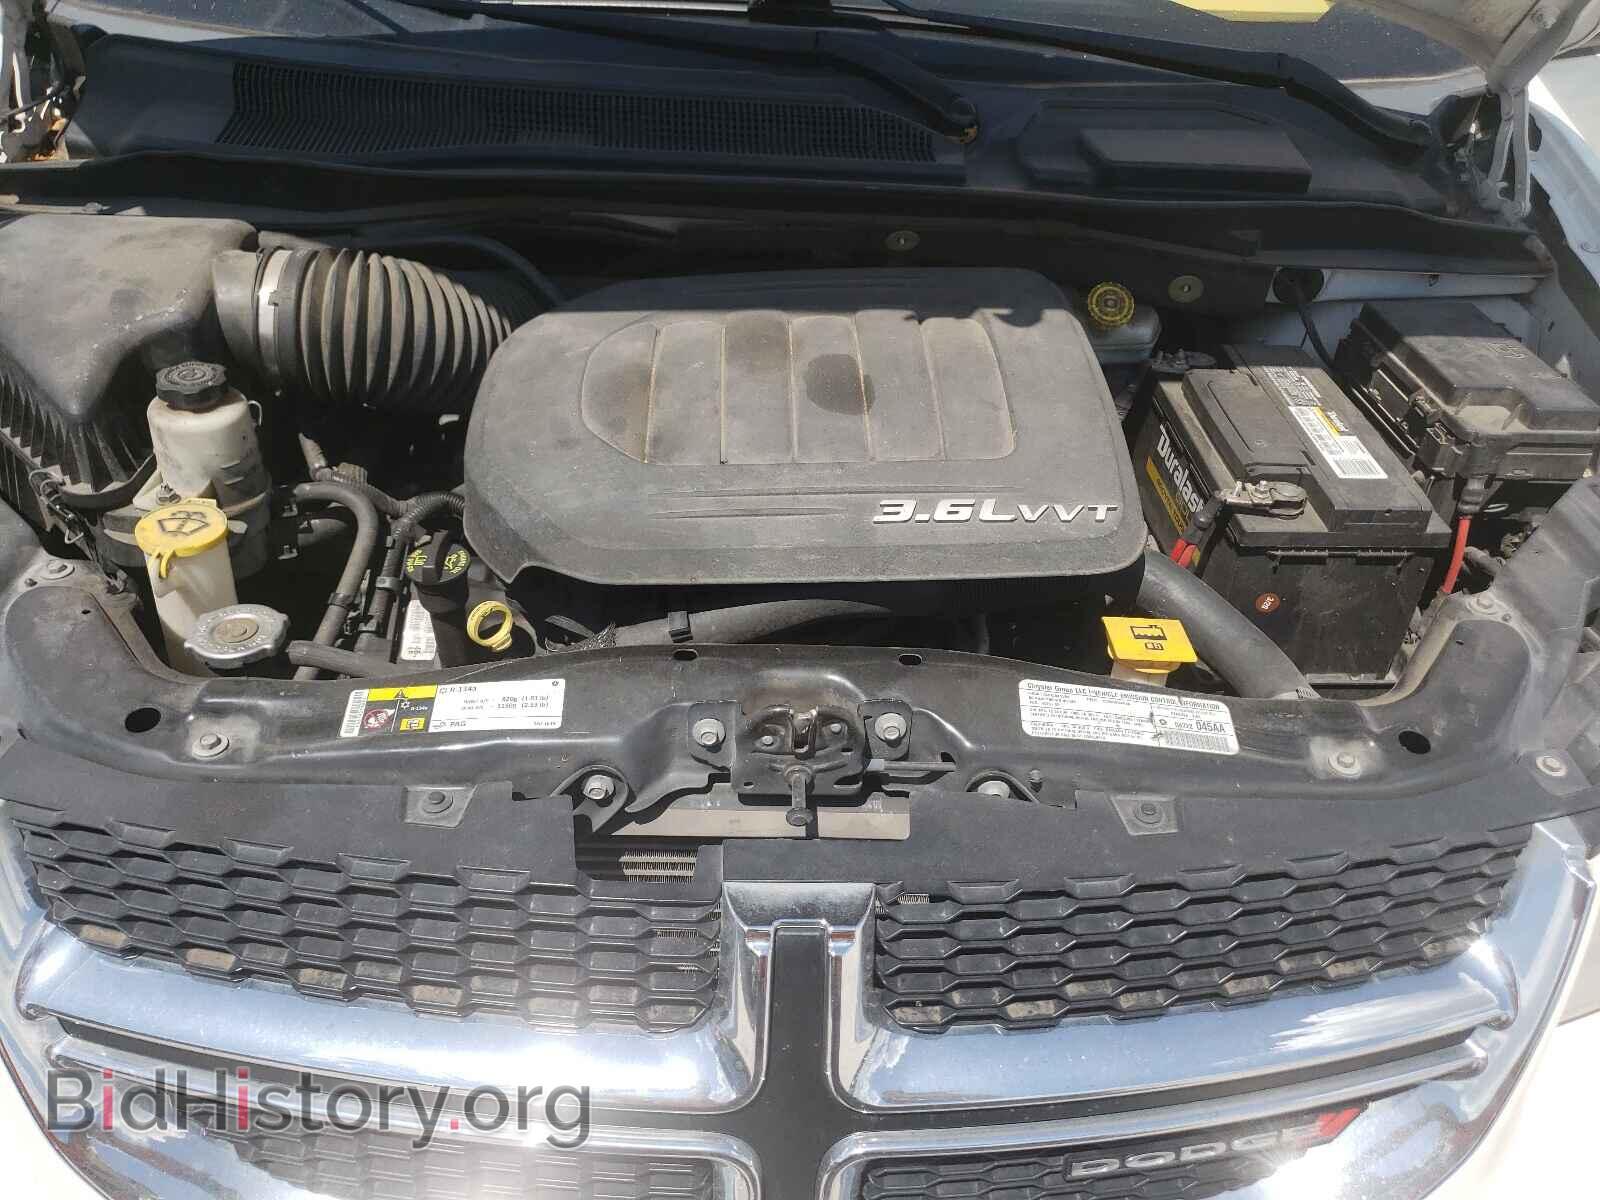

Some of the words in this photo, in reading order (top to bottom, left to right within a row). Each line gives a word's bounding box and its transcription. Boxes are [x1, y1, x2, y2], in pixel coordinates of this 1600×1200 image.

[1157, 423, 1204, 513] Duralast
[872, 498, 1017, 524] 3.6L
[1017, 503, 1120, 522] VVT
[1179, 700, 1220, 711] NFORMATION
